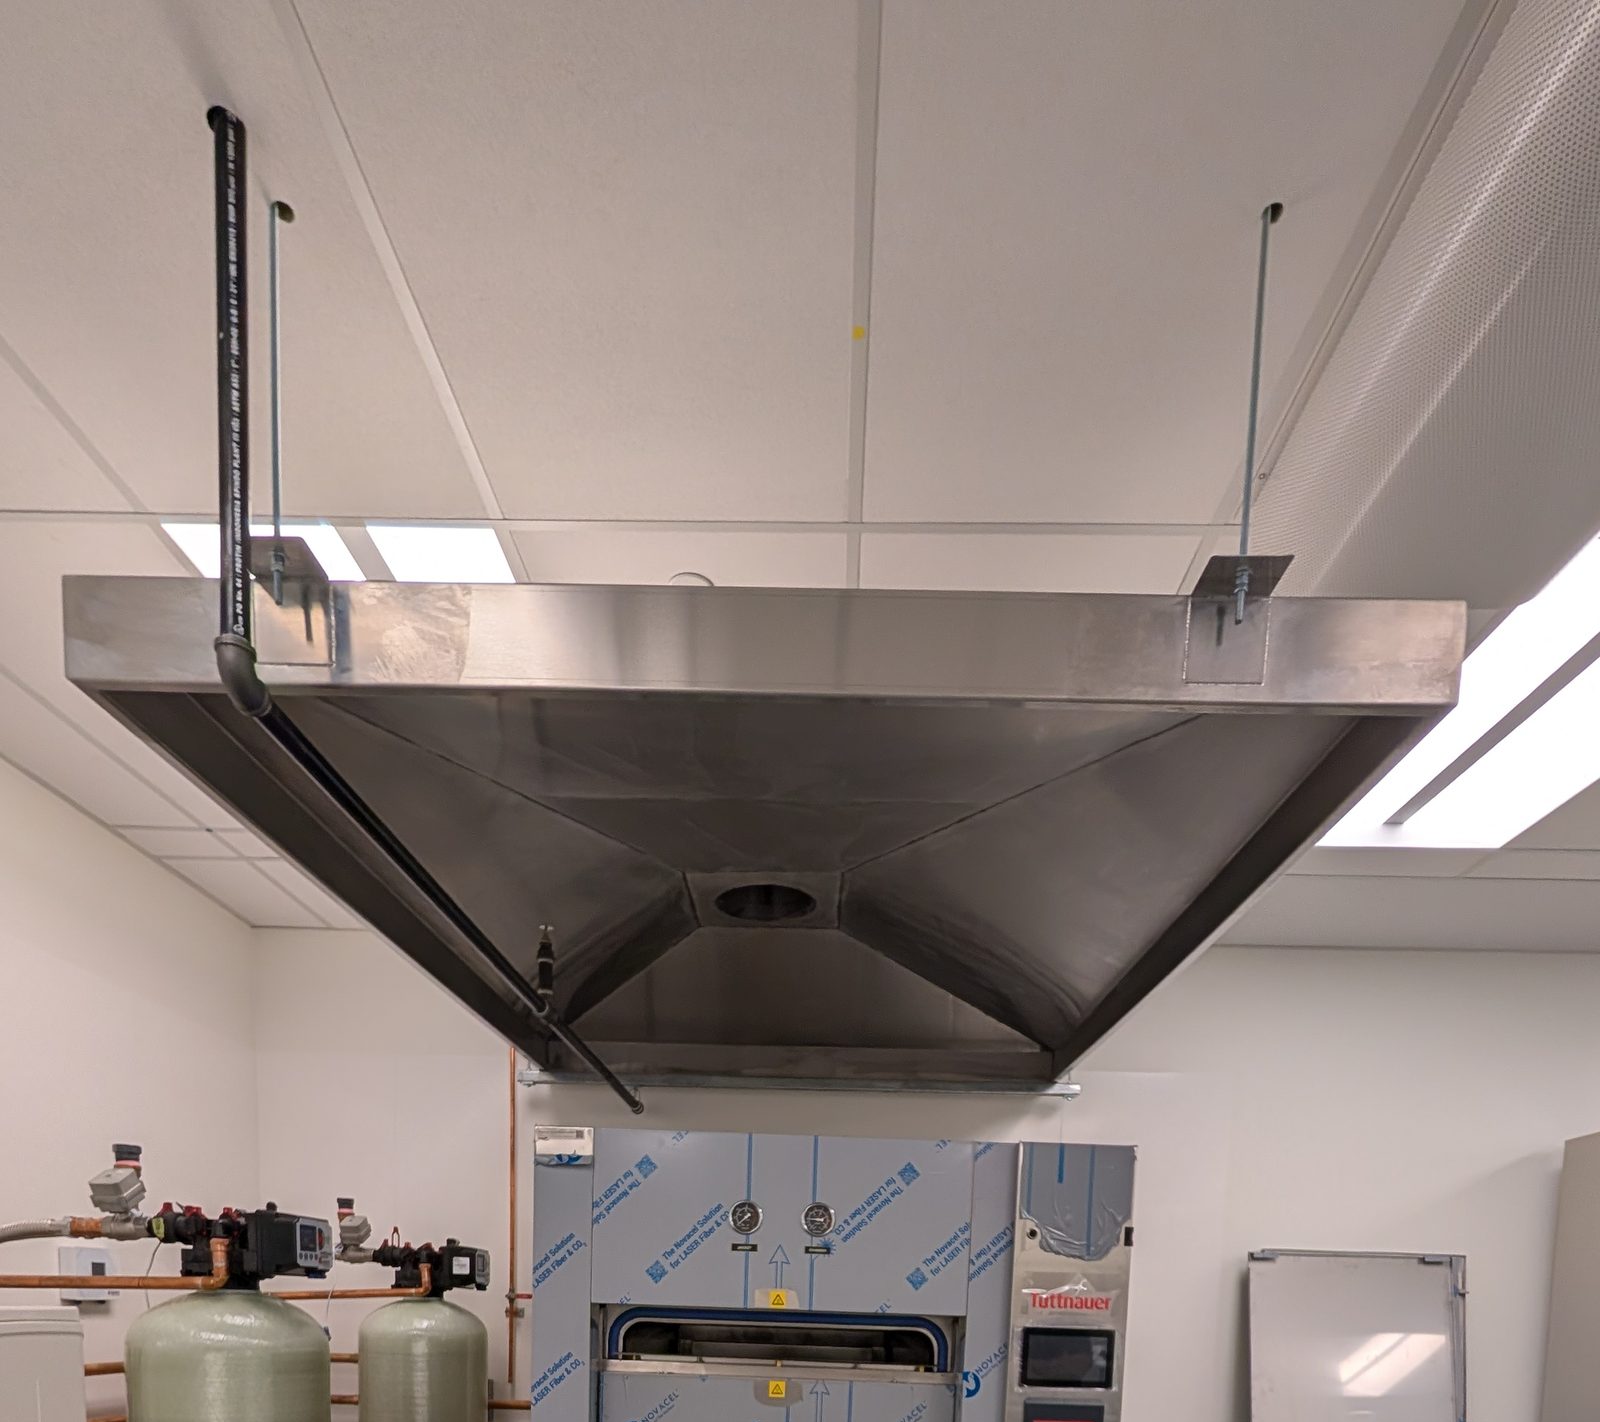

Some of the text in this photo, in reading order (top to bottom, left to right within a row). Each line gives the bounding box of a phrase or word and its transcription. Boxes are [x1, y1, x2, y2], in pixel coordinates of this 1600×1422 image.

[623, 1170, 633, 1180] for
[627, 1179, 641, 1190] The
[885, 1177, 896, 1187] for
[602, 1178, 624, 1199] LASER
[864, 1186, 886, 1207] LASER
[604, 1189, 629, 1214] Novacel
[849, 1204, 867, 1220] Fiber
[841, 1186, 903, 1242] The Novacel Solution
[662, 1204, 723, 1260] The Novacel Solution
[549, 1233, 575, 1256] Solution
[670, 1258, 681, 1269] for
[679, 1240, 701, 1260] LASER
[698, 1226, 716, 1242] Fiber
[922, 1232, 960, 1267] The Novacel
[551, 1254, 567, 1270] Fiber
[930, 1266, 941, 1276] for
[939, 1247, 962, 1267] LASER
[1031, 1292, 1111, 1311] Tuttnauer
[547, 1352, 573, 1375] Solution
[549, 1373, 565, 1388] Fiber
